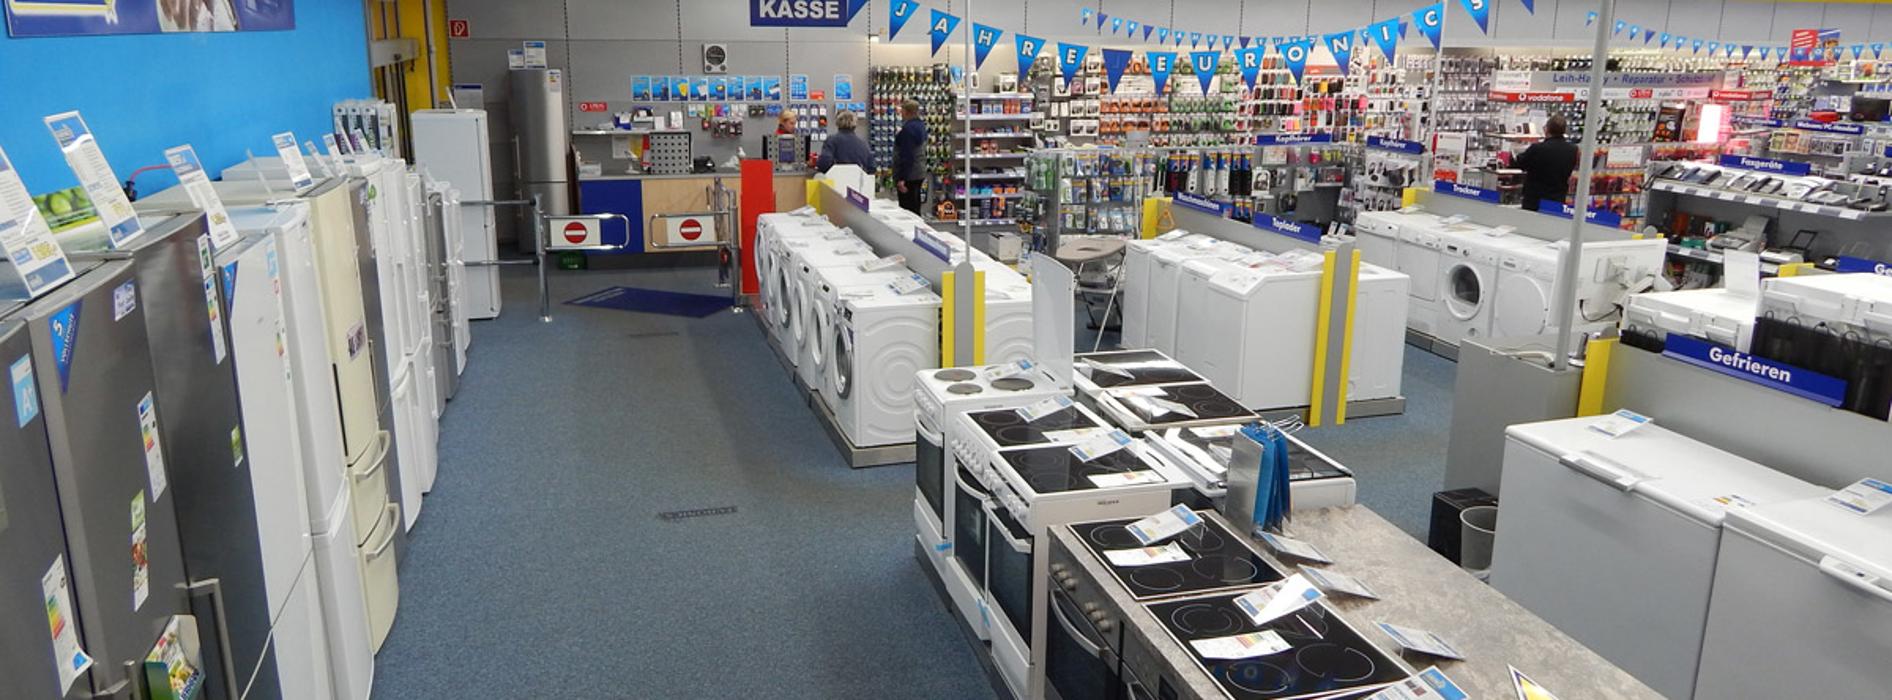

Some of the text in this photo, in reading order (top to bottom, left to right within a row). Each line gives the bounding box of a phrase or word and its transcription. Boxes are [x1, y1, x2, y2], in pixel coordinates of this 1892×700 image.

[759, 0, 839, 18] KASSE
[1553, 73, 1608, 86] Leih-Hay
[1527, 94, 1564, 102] vodafone
[1740, 157, 1784, 170] Faxgeräte
[1452, 184, 1481, 197] Trockner
[1272, 216, 1302, 233] Toplader
[1709, 346, 1791, 383] Gefrieren
